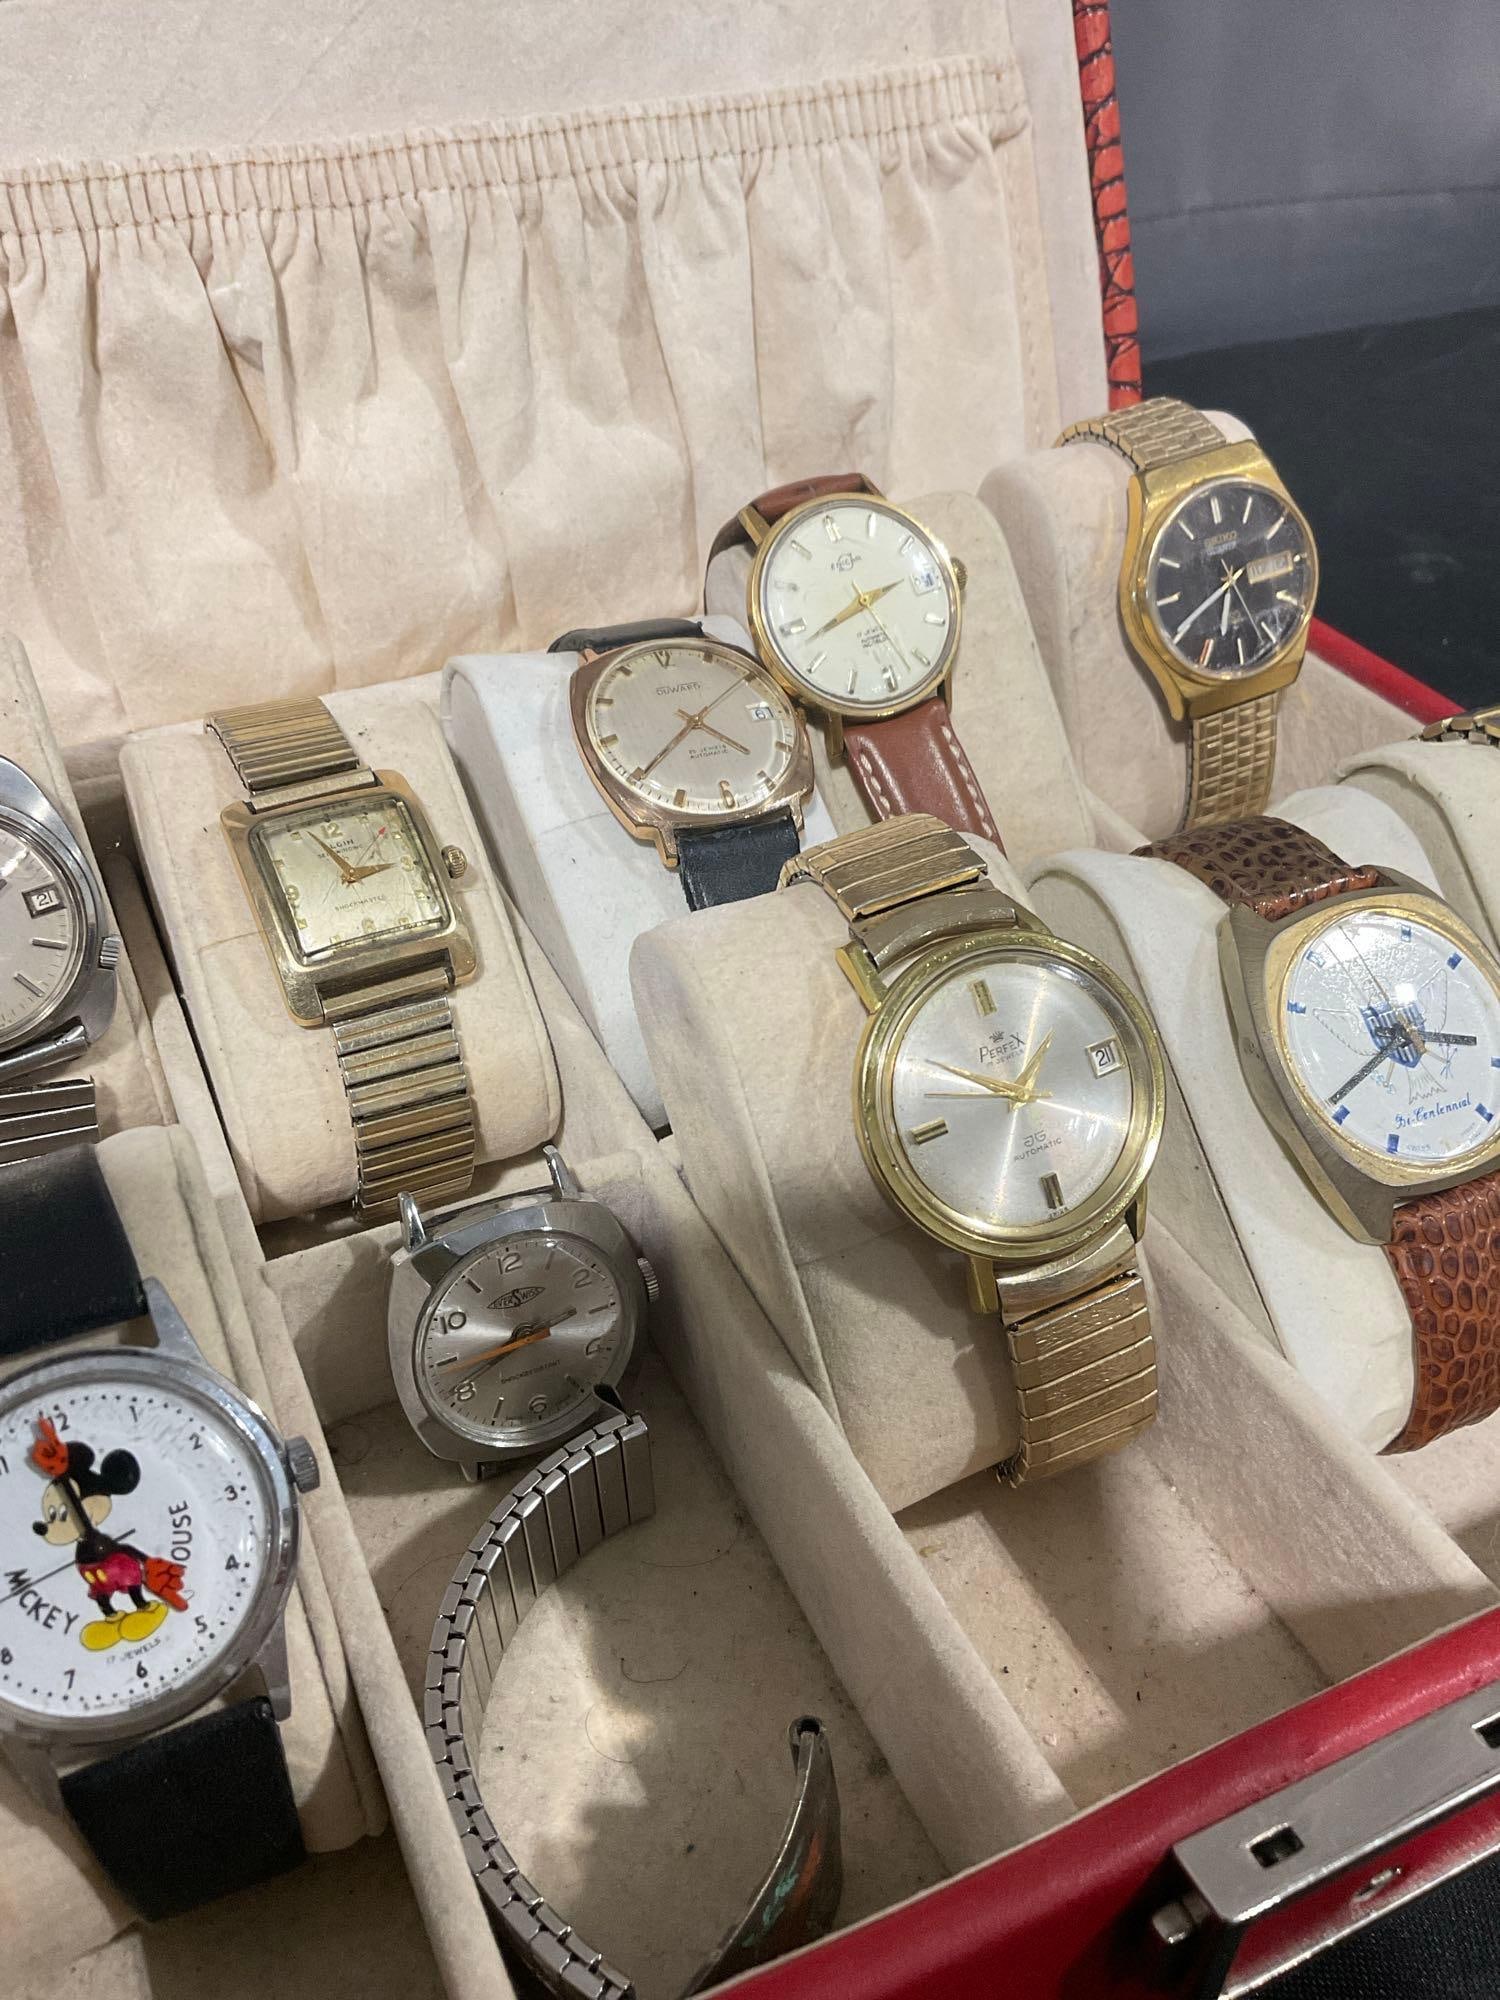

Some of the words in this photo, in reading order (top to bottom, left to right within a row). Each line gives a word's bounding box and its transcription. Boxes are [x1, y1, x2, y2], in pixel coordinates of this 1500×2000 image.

[319, 822, 343, 839] 12
[37, 892, 53, 906] 21
[1096, 1046, 1111, 1067] 21
[1014, 1137, 1062, 1161] AUTOMATIC
[498, 1252, 523, 1274] 12
[572, 1268, 592, 1289] 2
[440, 1311, 467, 1335] 10
[529, 1394, 548, 1414] 6
[189, 1432, 203, 1450] 2
[224, 1485, 239, 1501] 3
[168, 1500, 193, 1562] OUSE
[225, 1554, 240, 1571] 4
[194, 1615, 208, 1634] 5
[1, 1647, 13, 1665] 8
[136, 1660, 148, 1678] 6
[64, 1668, 76, 1690] 7
